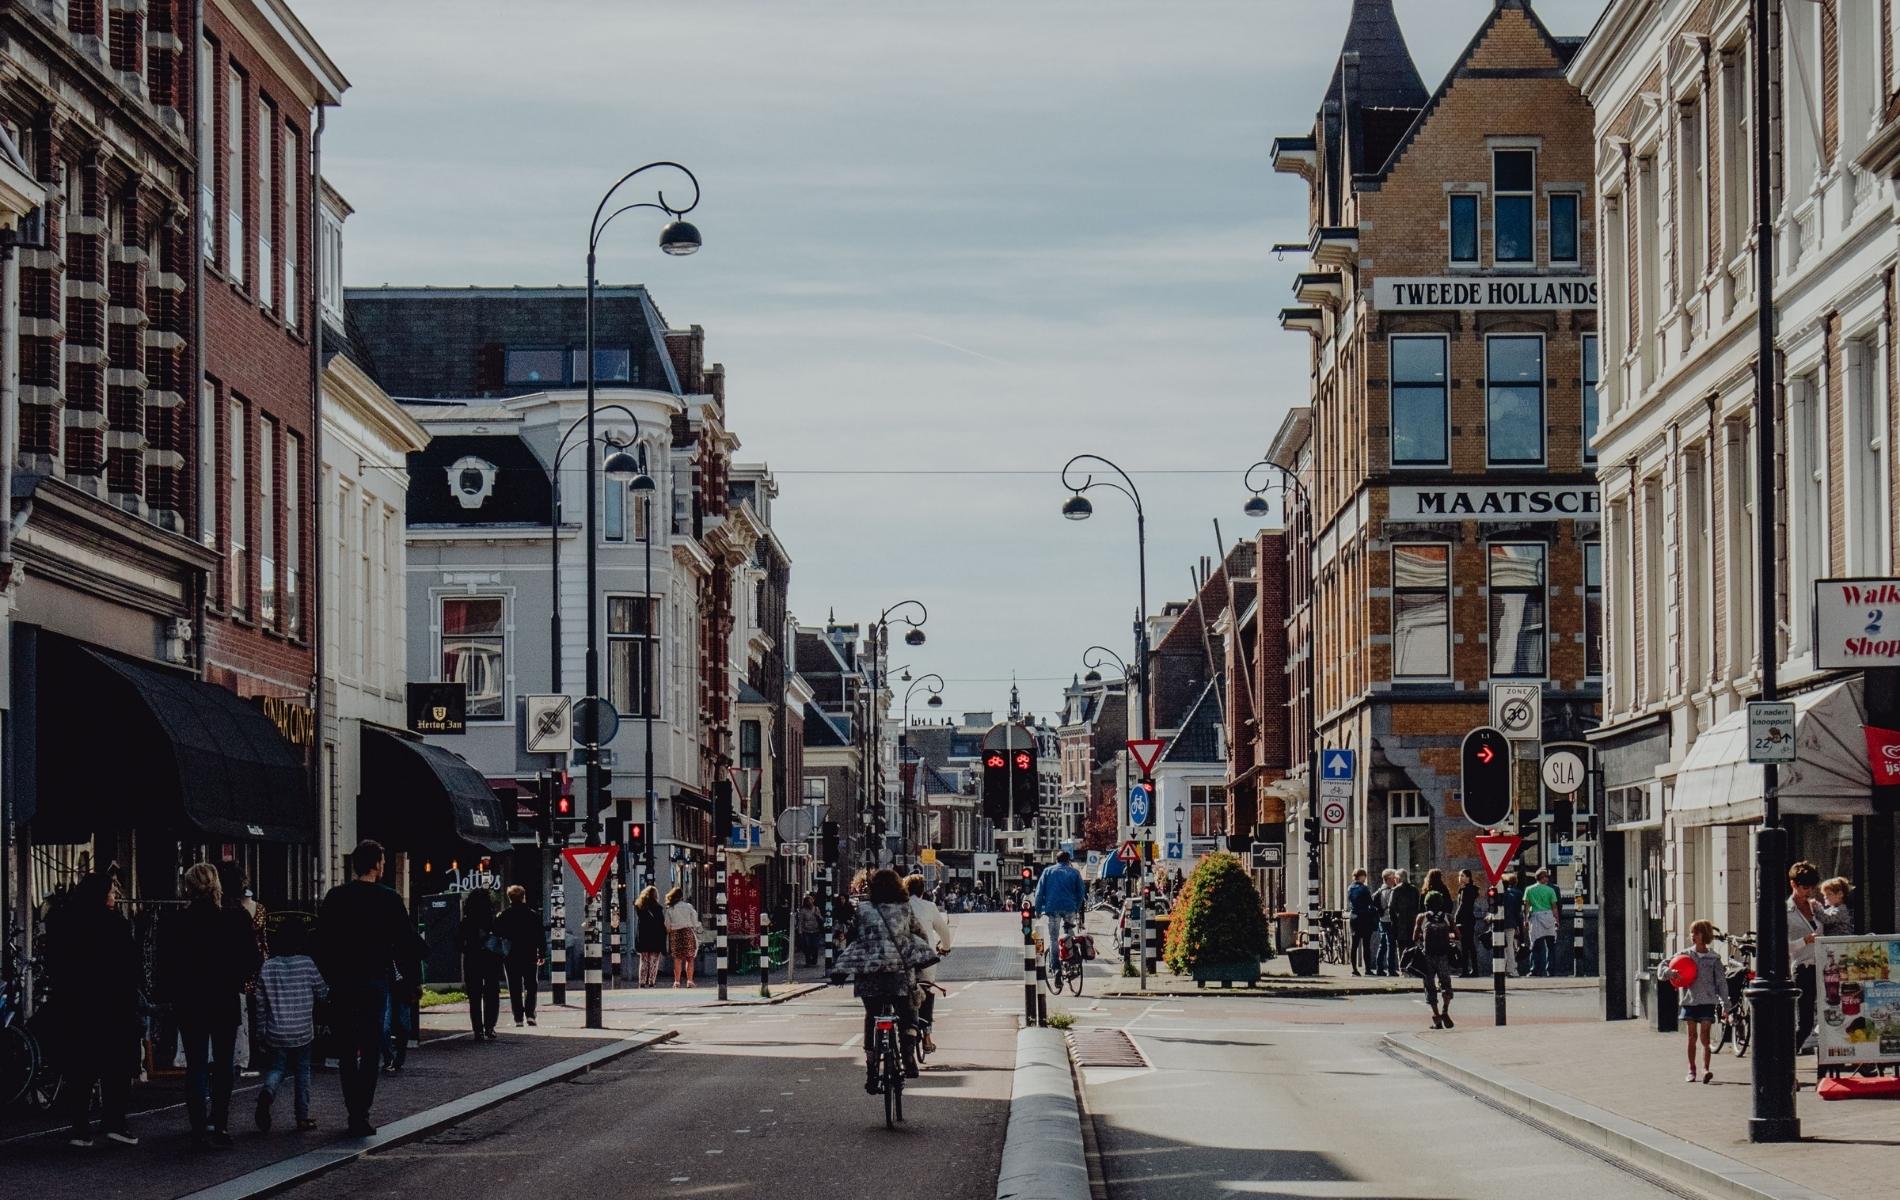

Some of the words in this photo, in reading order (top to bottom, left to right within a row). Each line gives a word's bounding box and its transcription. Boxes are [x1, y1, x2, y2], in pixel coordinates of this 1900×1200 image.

[1393, 283, 1482, 305] TWEEDE
[1488, 283, 1597, 305] HOLLANDS
[1842, 585, 1900, 607] Walk
[1864, 609, 1883, 634] 2
[1508, 708, 1527, 721] 30
[1763, 708, 1789, 716] nadert
[290, 703, 315, 746] CINTA
[417, 720, 446, 731] Hertog
[447, 720, 462, 729] Jan
[1752, 718, 1792, 727] knooppunt
[1755, 738, 1770, 749] 22
[1552, 762, 1575, 784] SLA
[1884, 761, 1900, 775] ijs
[1328, 809, 1341, 818] 30
